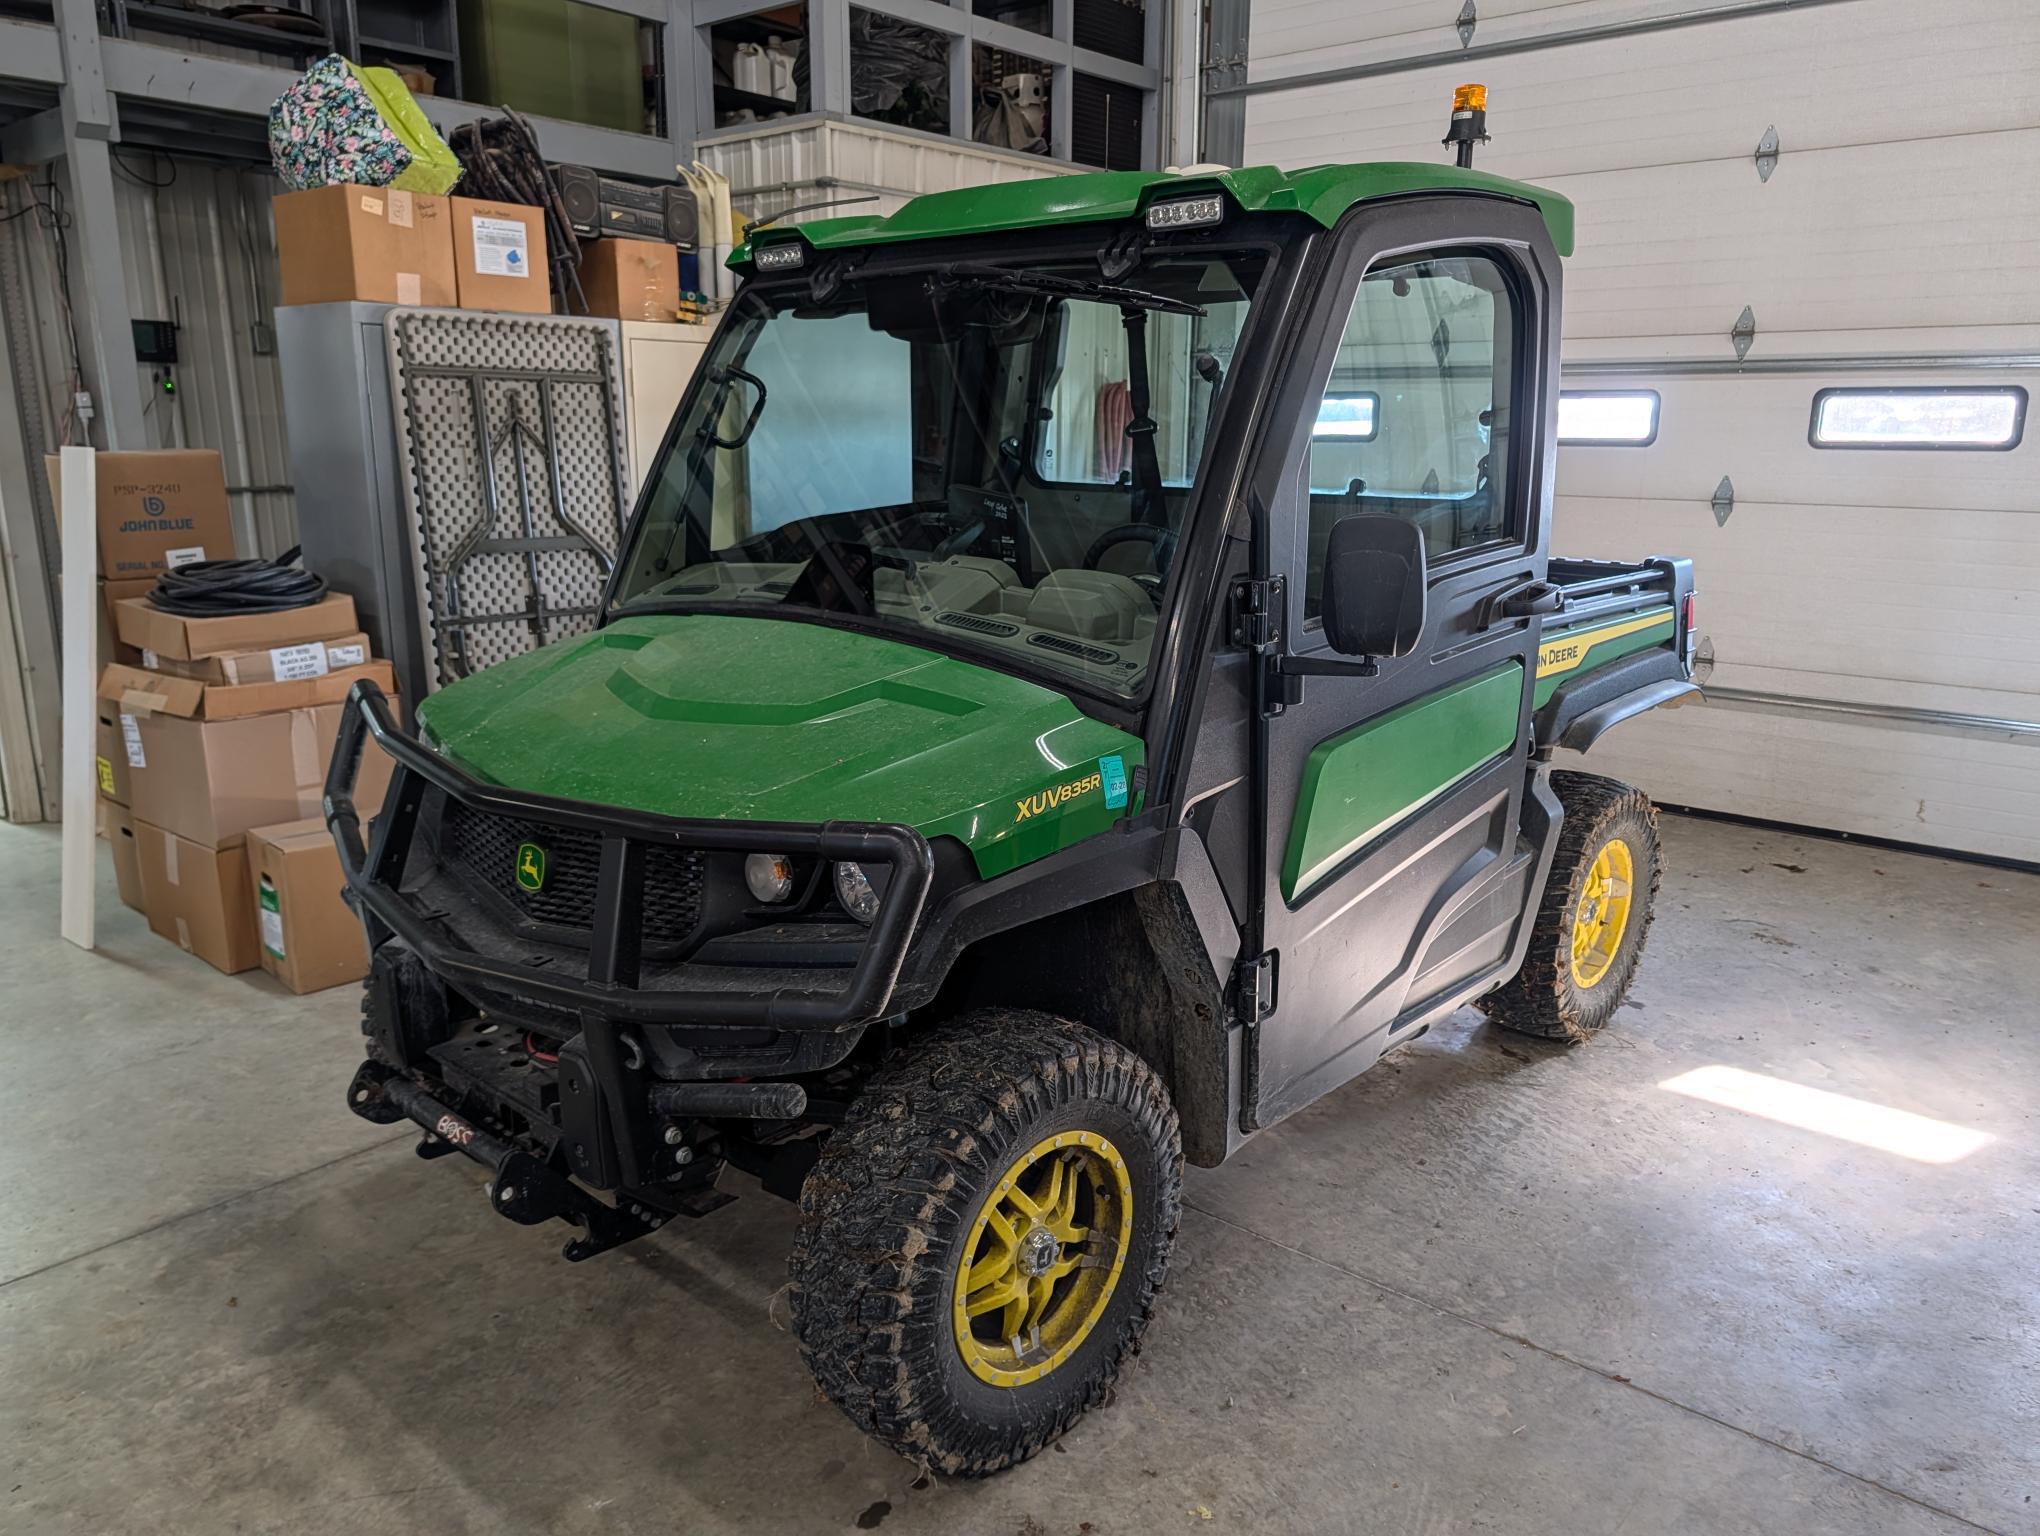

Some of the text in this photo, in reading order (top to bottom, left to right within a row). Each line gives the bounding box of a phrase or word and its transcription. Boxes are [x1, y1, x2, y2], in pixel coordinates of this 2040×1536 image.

[1549, 645, 1578, 665] DEERE
[1015, 773, 1101, 822] XUV835R
[437, 1115, 474, 1145] BOSS
